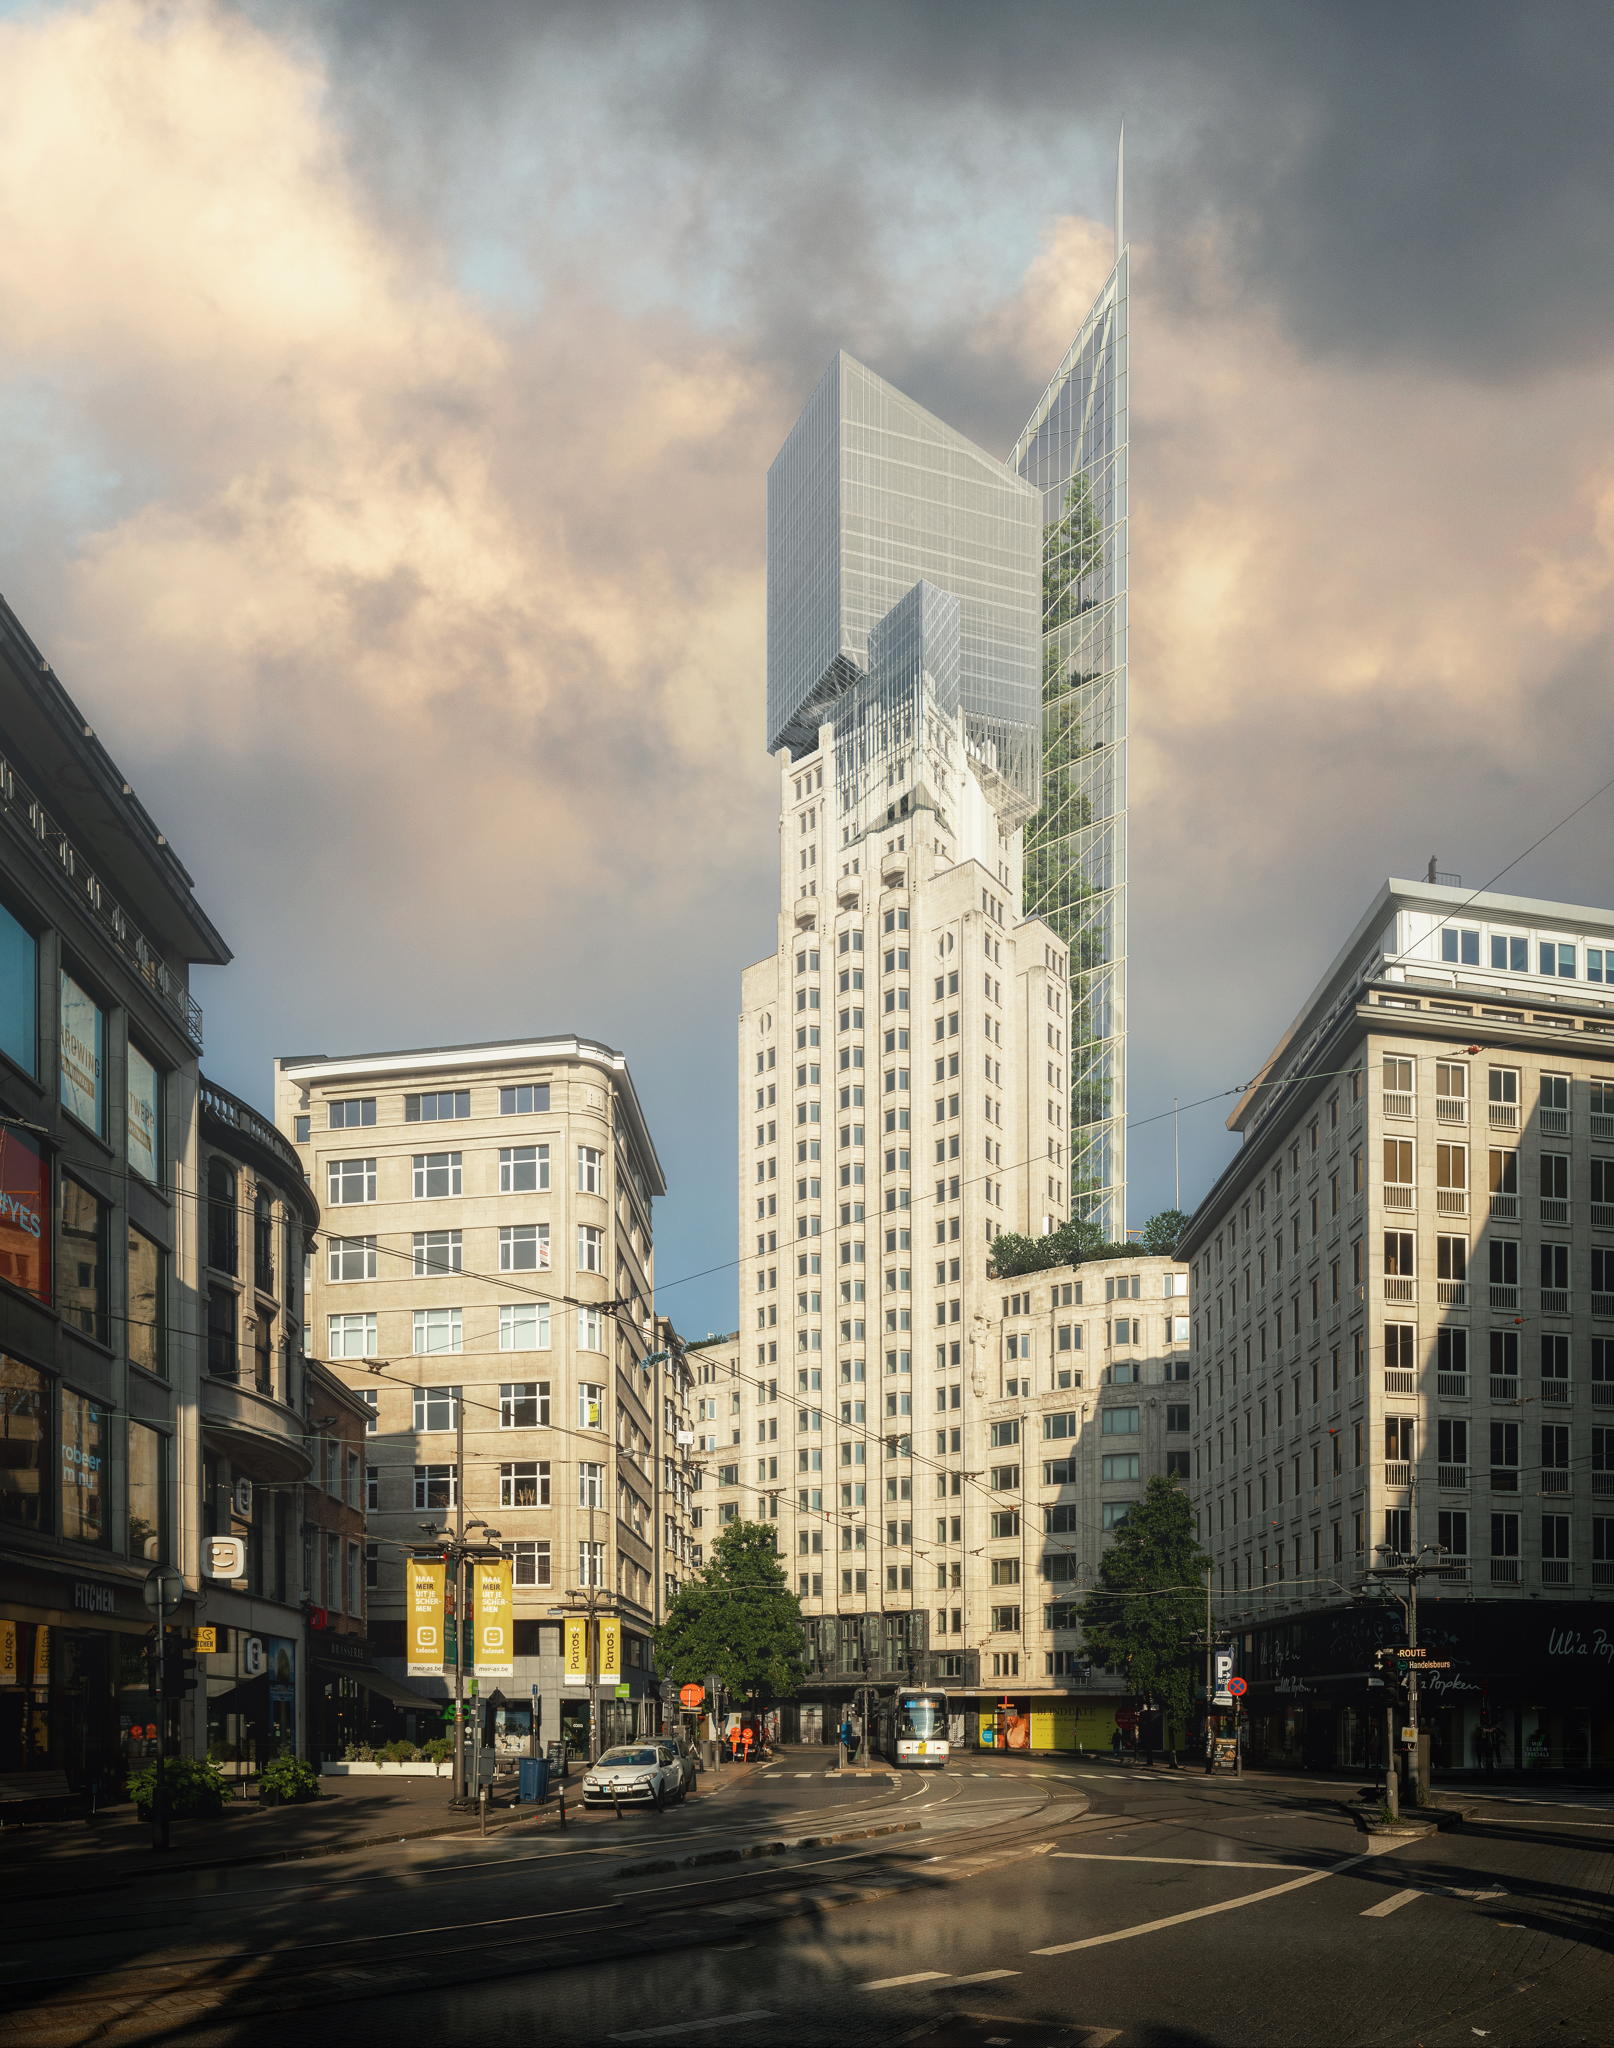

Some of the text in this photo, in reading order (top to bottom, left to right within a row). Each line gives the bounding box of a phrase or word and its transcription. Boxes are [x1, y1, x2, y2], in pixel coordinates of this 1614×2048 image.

[75, 1583, 115, 1613] FITCHEN
[571, 1633, 579, 1669] Panos
[606, 1633, 614, 1669] Panos
[1217, 1656, 1232, 1678] P
[1428, 1671, 1483, 1696] Popken
